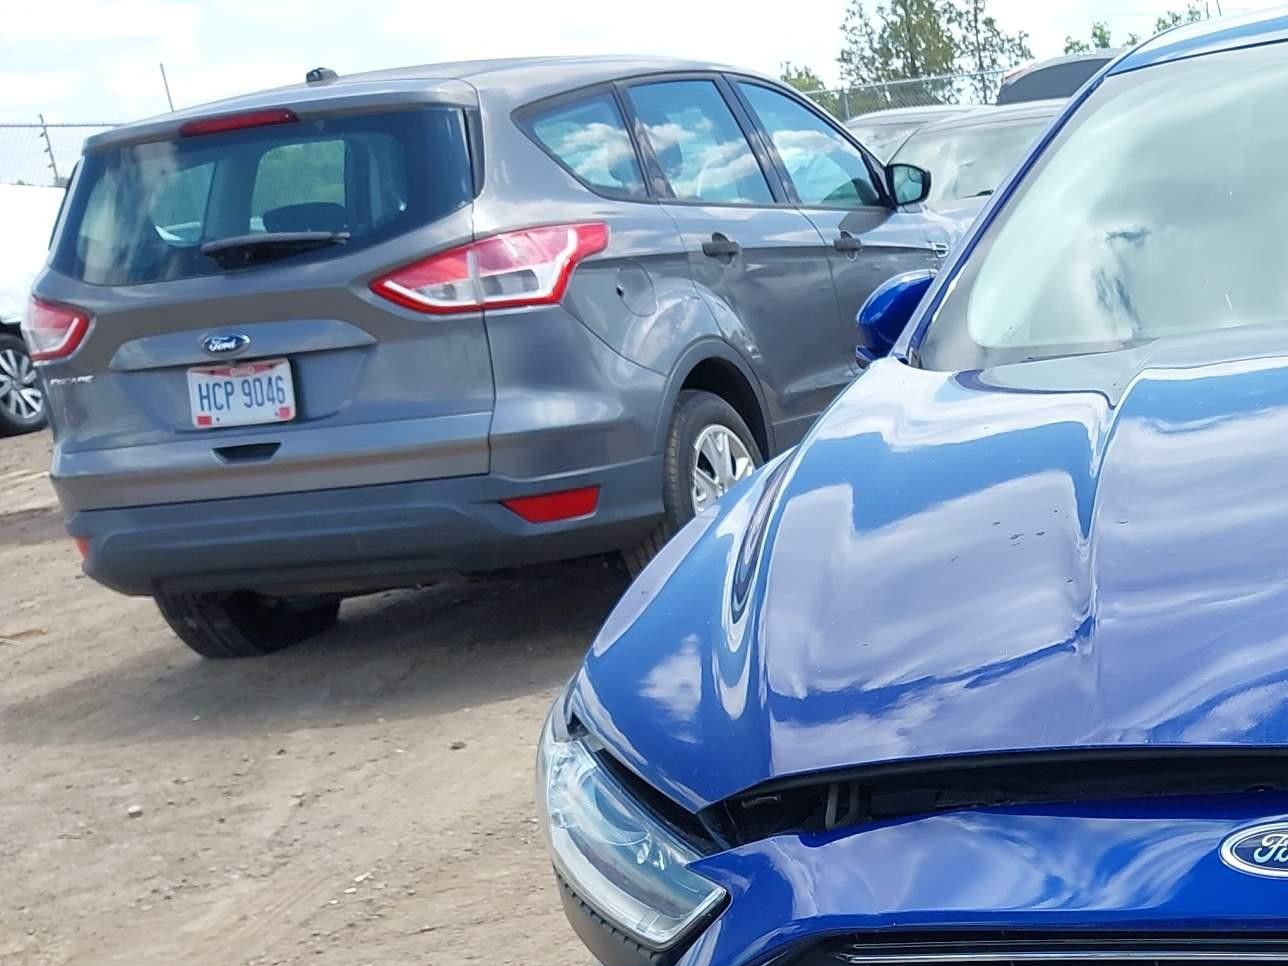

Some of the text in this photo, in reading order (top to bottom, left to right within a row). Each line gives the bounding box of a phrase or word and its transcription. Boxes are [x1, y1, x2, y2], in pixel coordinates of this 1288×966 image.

[208, 337, 237, 352] Ford
[198, 376, 286, 412] HCP 9046
